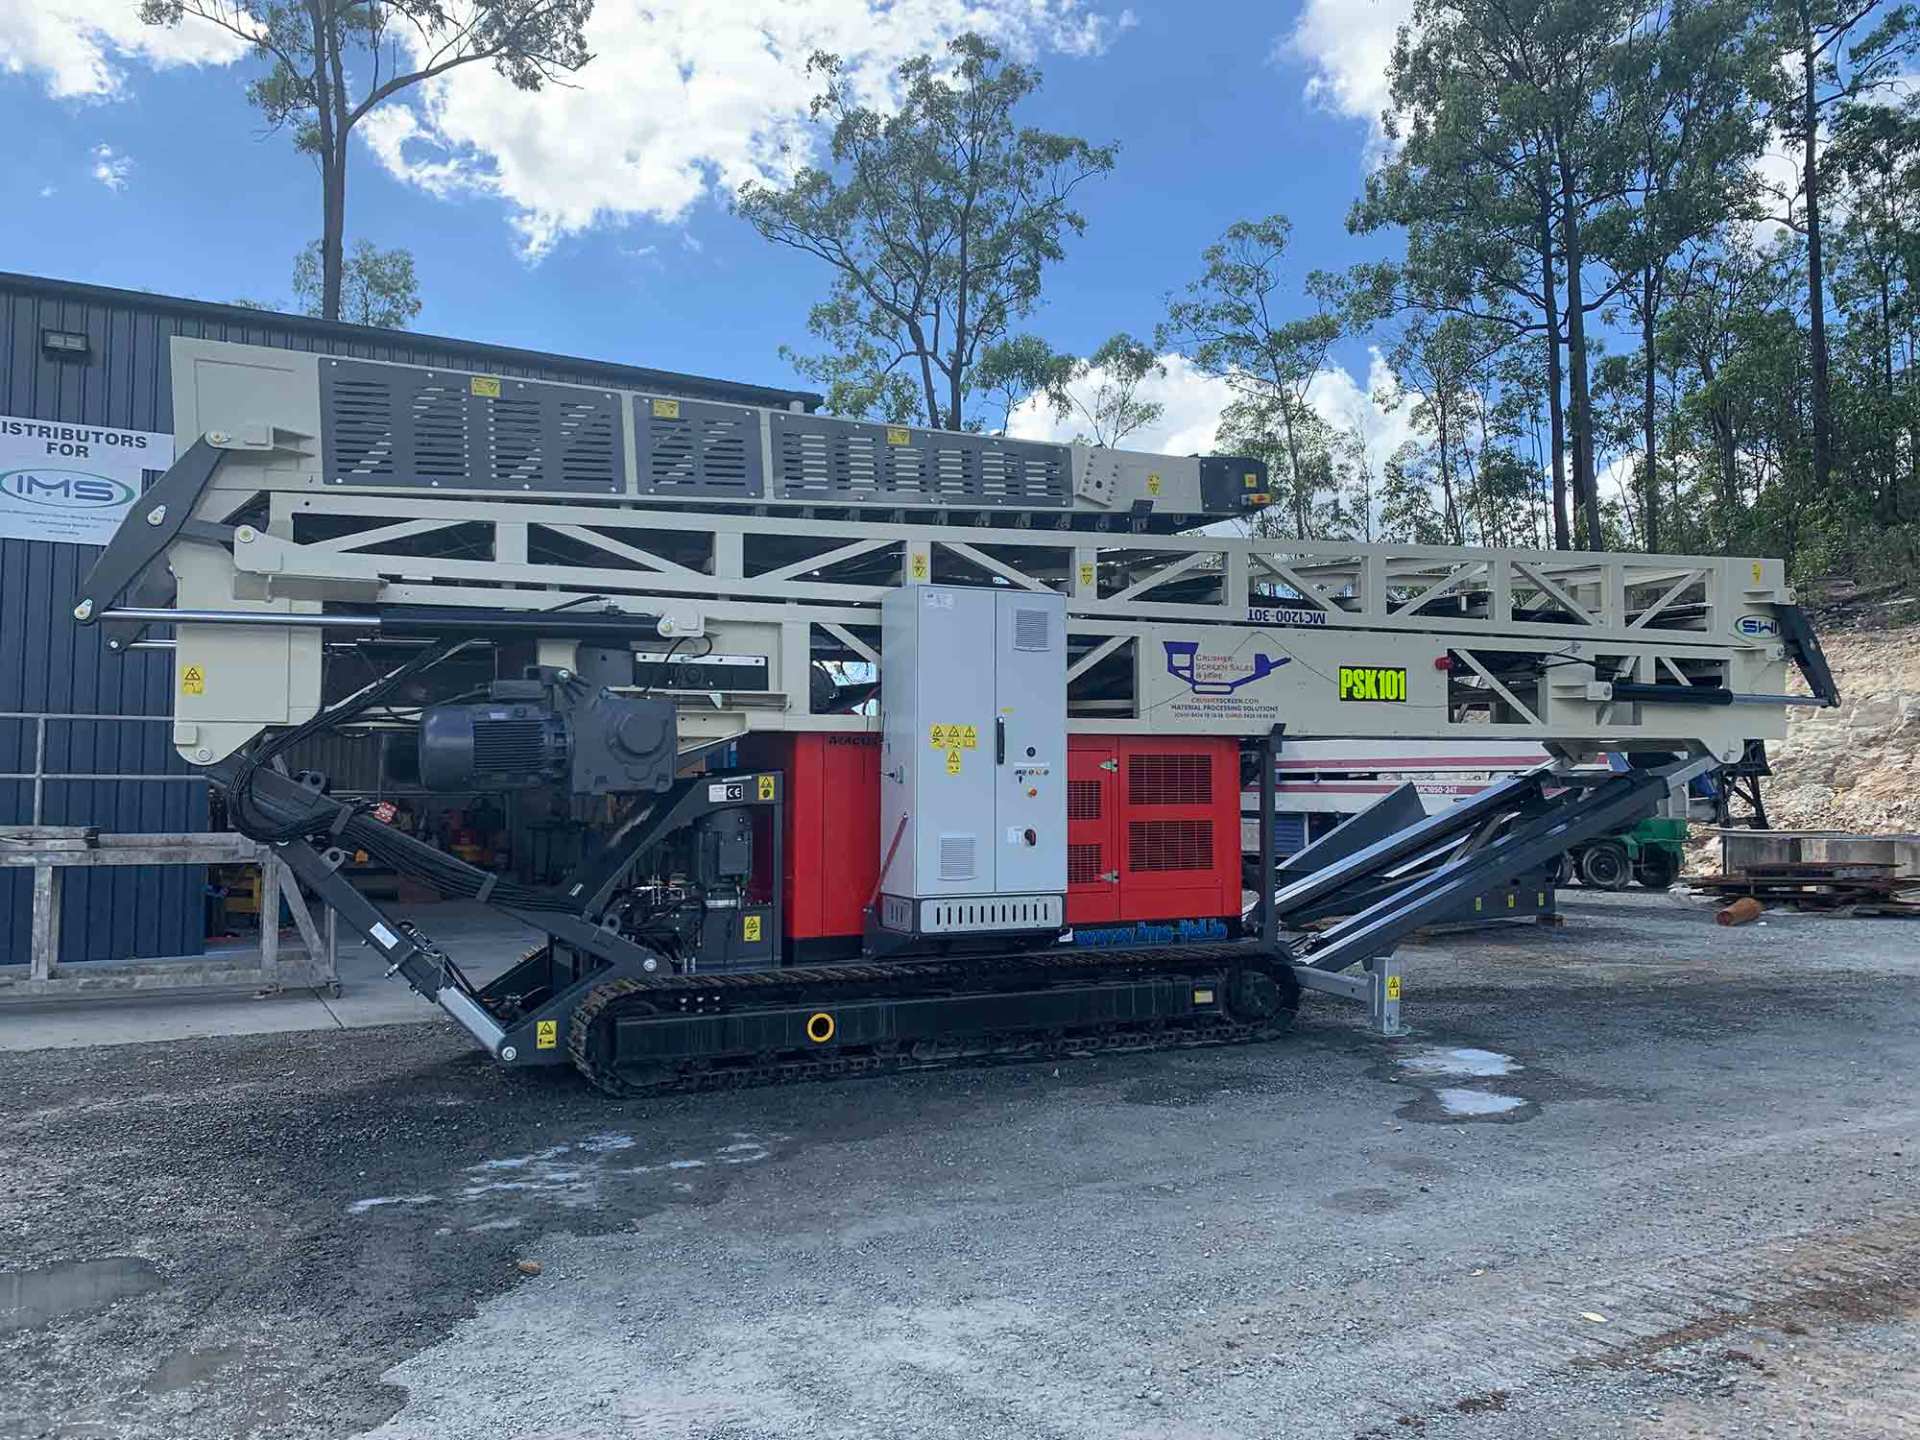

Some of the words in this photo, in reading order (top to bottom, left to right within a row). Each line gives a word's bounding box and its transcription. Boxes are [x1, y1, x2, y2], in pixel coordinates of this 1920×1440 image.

[1, 420, 147, 449] ISTRIBUTORS
[46, 442, 89, 458] FOR
[17, 475, 114, 502] IMS
[1247, 608, 1327, 625] MC1200-30T
[1340, 667, 1406, 701] PSK101
[1171, 704, 1201, 712] MATERIAL
[1203, 704, 1242, 712] PROCESSING
[1243, 705, 1279, 713] SOLUTIONS
